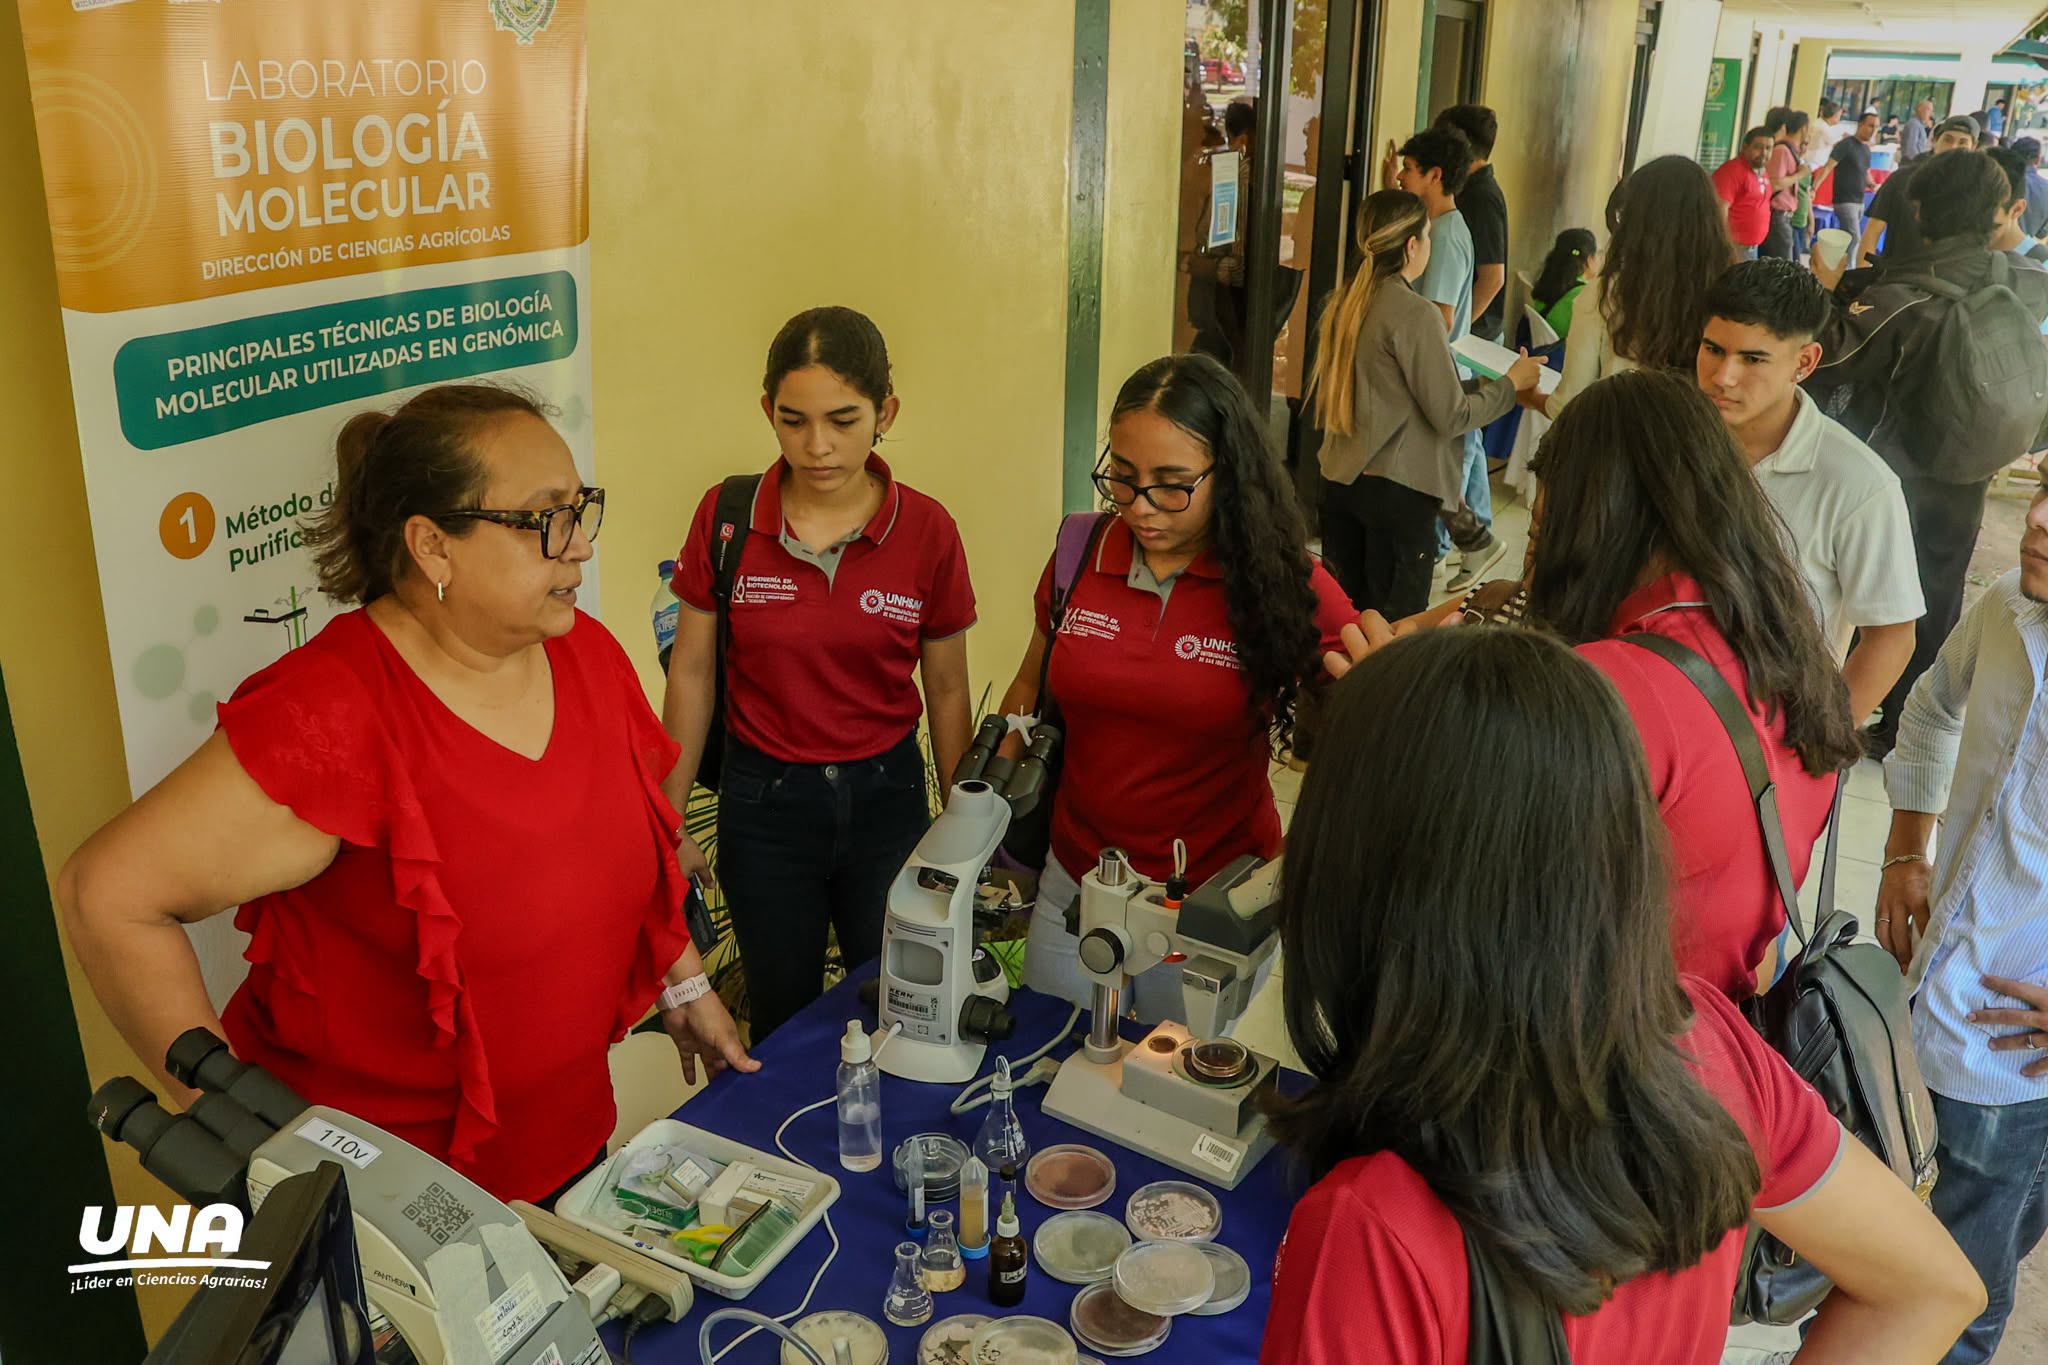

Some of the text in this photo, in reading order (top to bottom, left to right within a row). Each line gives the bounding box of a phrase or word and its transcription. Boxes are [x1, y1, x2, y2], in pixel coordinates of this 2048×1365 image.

[201, 59, 487, 101] LABORATORIO
[207, 99, 489, 179] BIOLOGÍA
[215, 171, 492, 238] MOLECULAR
[201, 224, 512, 281] DIRECCIÓN DE CIENCIAS AGRÍCOLAS
[166, 289, 553, 382] PRINCIPALES TÉCNICAS DE BIOLOGÍA
[154, 318, 565, 420] MOLECULAR UTILIZADAS EN GENÓMICA
[178, 505, 197, 545] 1
[225, 482, 336, 539] Método d
[229, 527, 304, 573] Purific
[746, 582, 799, 591] BIOTECNOLOGÍA
[1202, 637, 1239, 654] UNHS
[889, 987, 914, 999] KERN
[316, 1126, 370, 1163] 110v
[373, 1269, 410, 1290] PANTHERA
